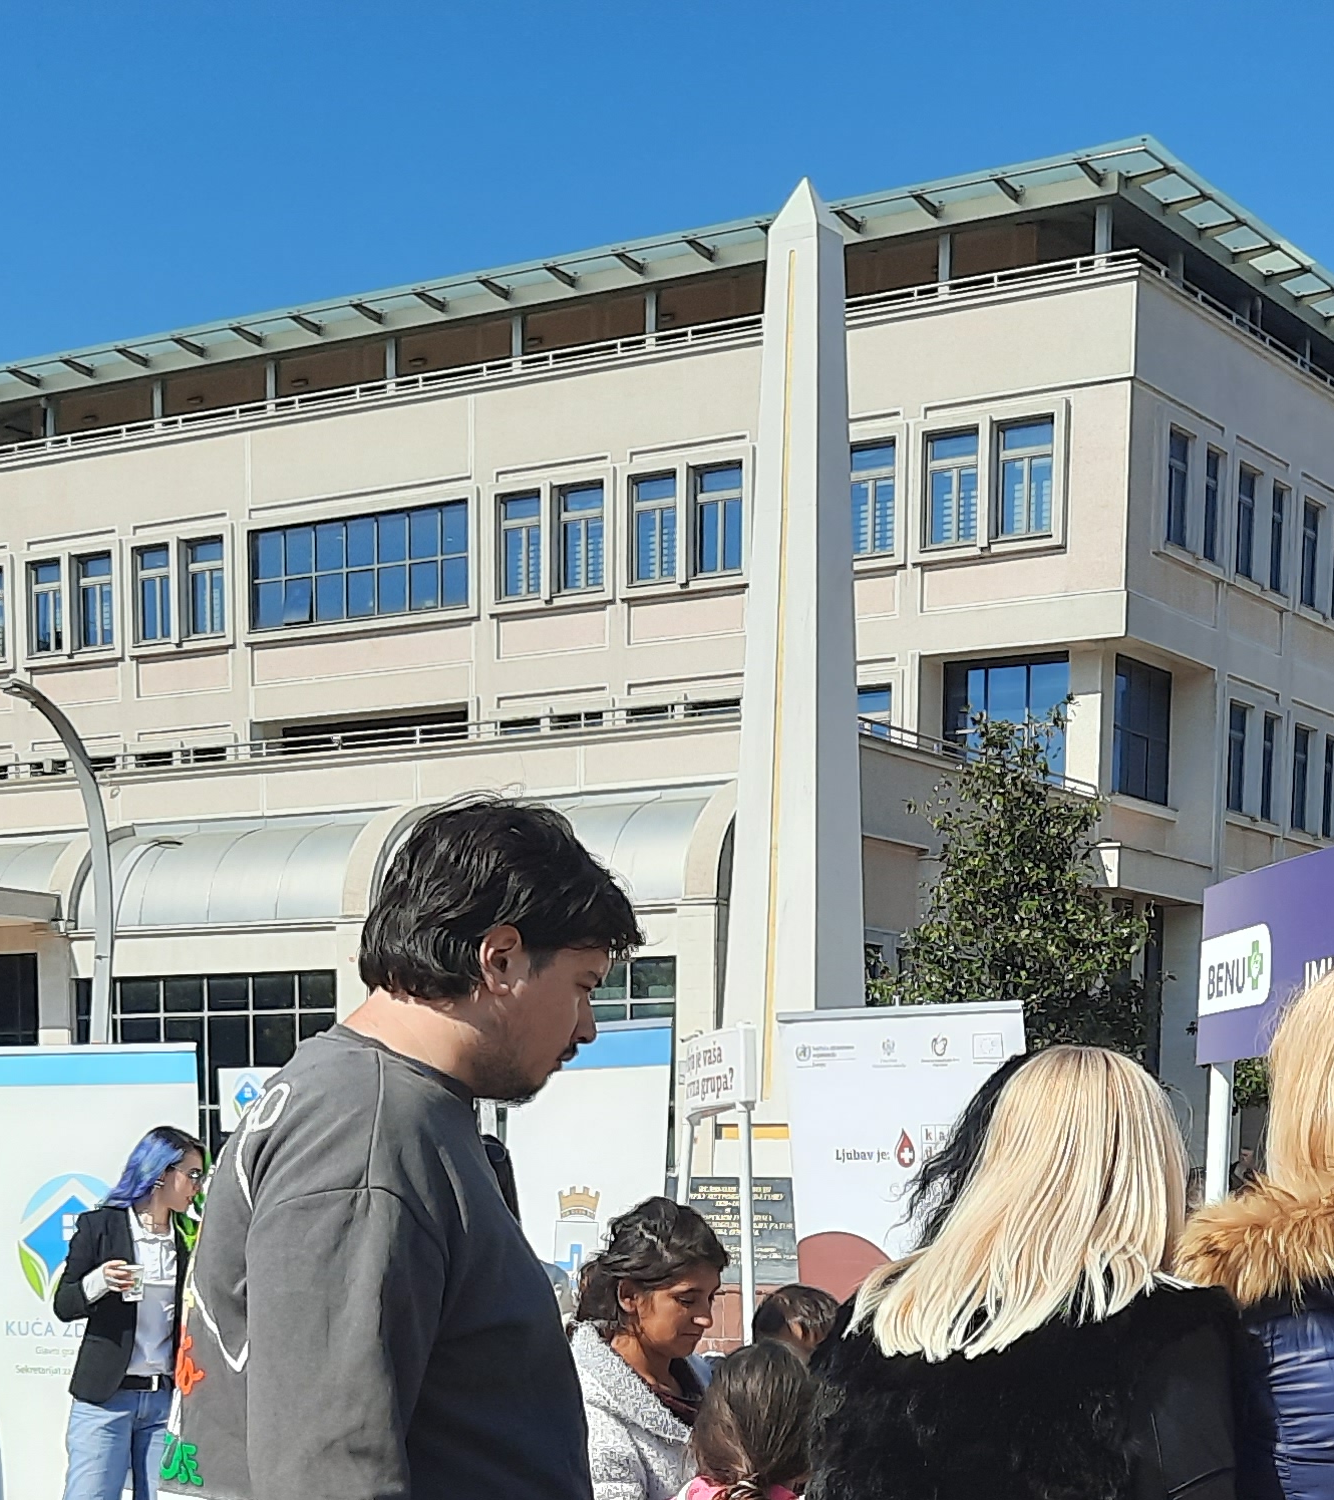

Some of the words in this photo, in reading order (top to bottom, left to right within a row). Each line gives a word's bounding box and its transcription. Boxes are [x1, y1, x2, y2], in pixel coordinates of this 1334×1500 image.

[1207, 956, 1246, 1000] BENU
[703, 1041, 723, 1067] vaša
[701, 1067, 734, 1101] grupa?
[835, 1149, 874, 1164] Ljubav
[5, 1317, 55, 1337] KUĆA
